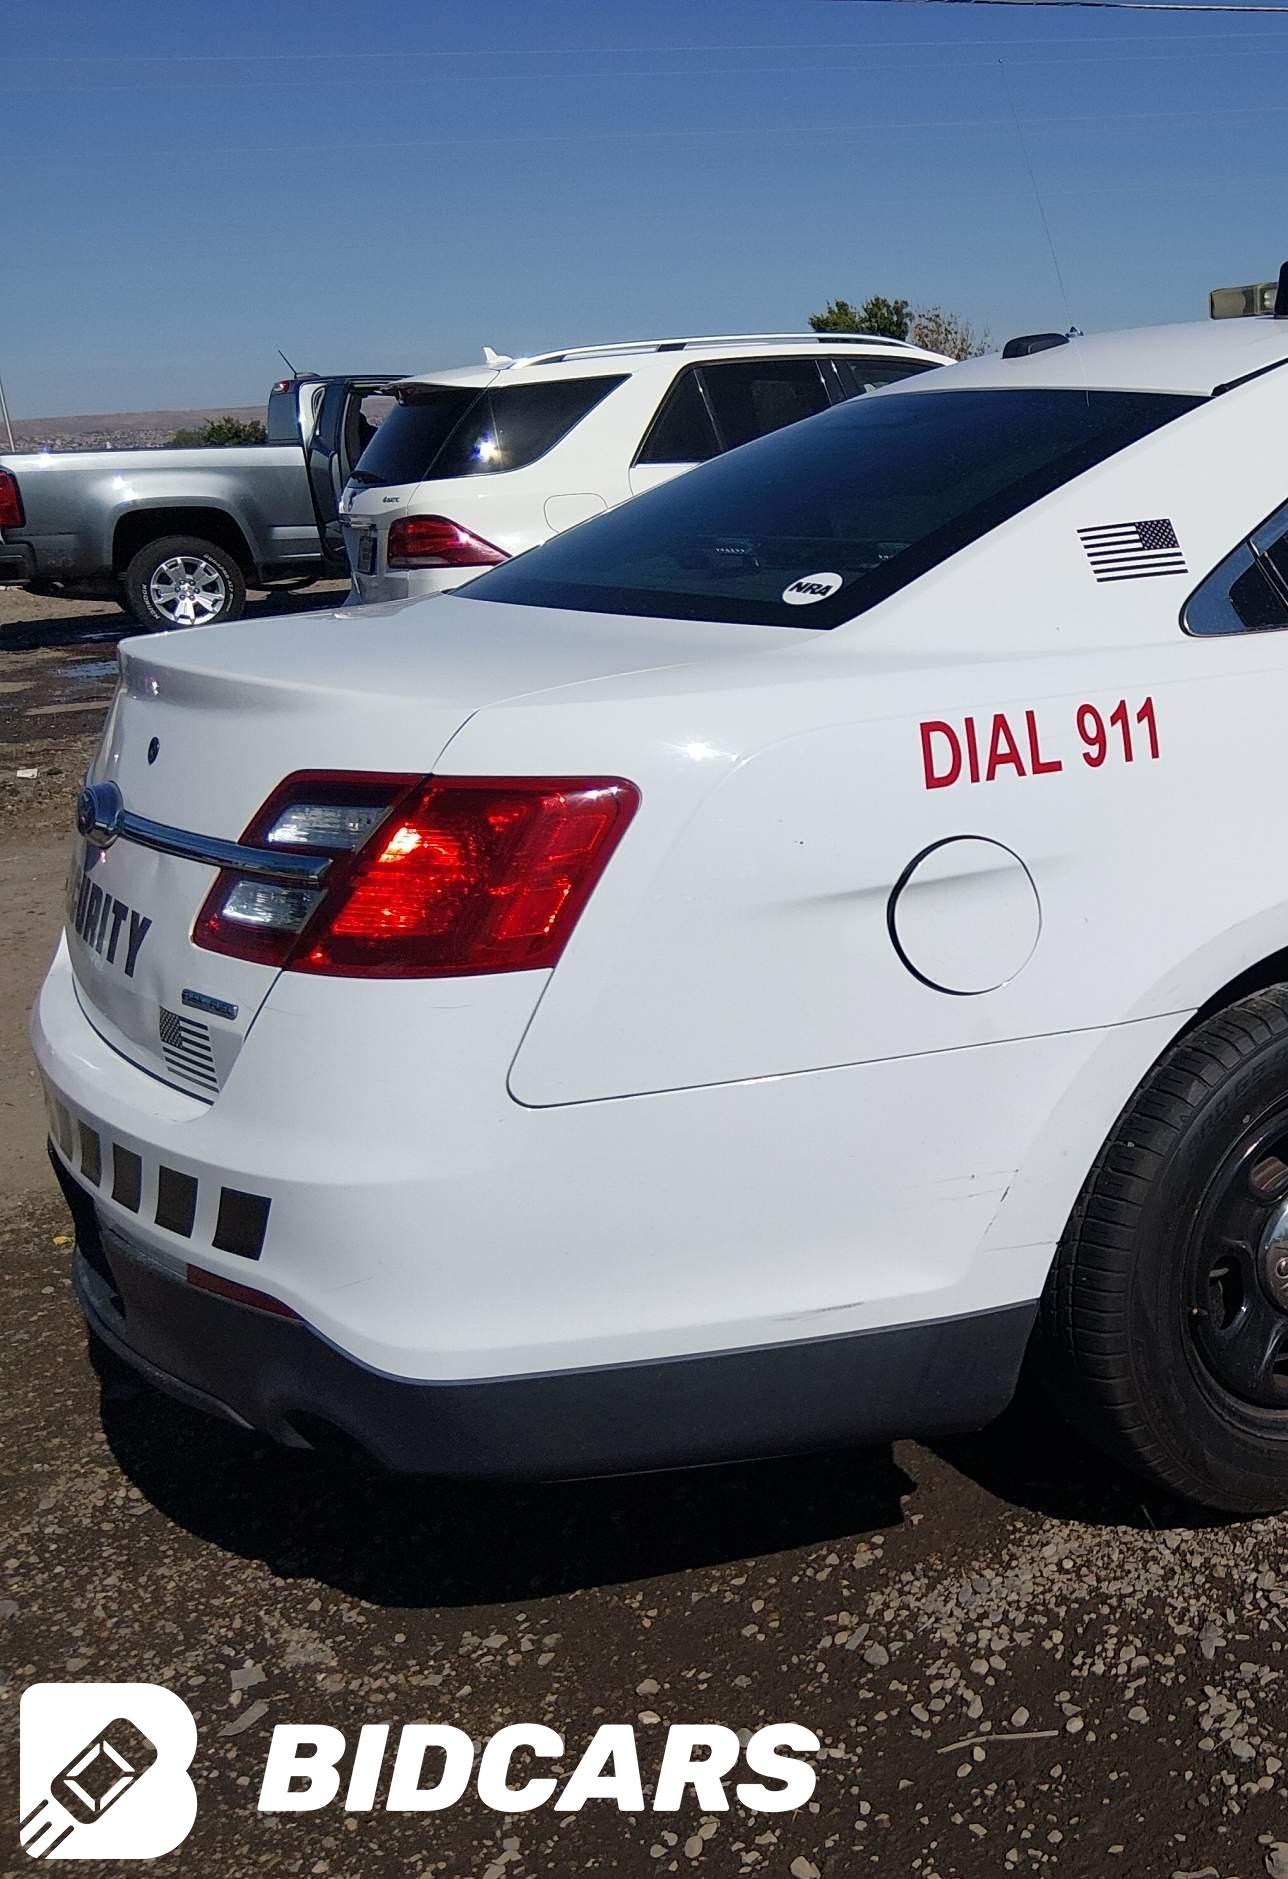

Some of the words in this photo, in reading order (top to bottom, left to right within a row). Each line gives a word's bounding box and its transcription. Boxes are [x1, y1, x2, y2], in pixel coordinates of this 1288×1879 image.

[791, 581, 832, 598] NRA
[919, 710, 1063, 790] DIAL
[1076, 696, 1160, 768] 911
[70, 868, 153, 978] URITY
